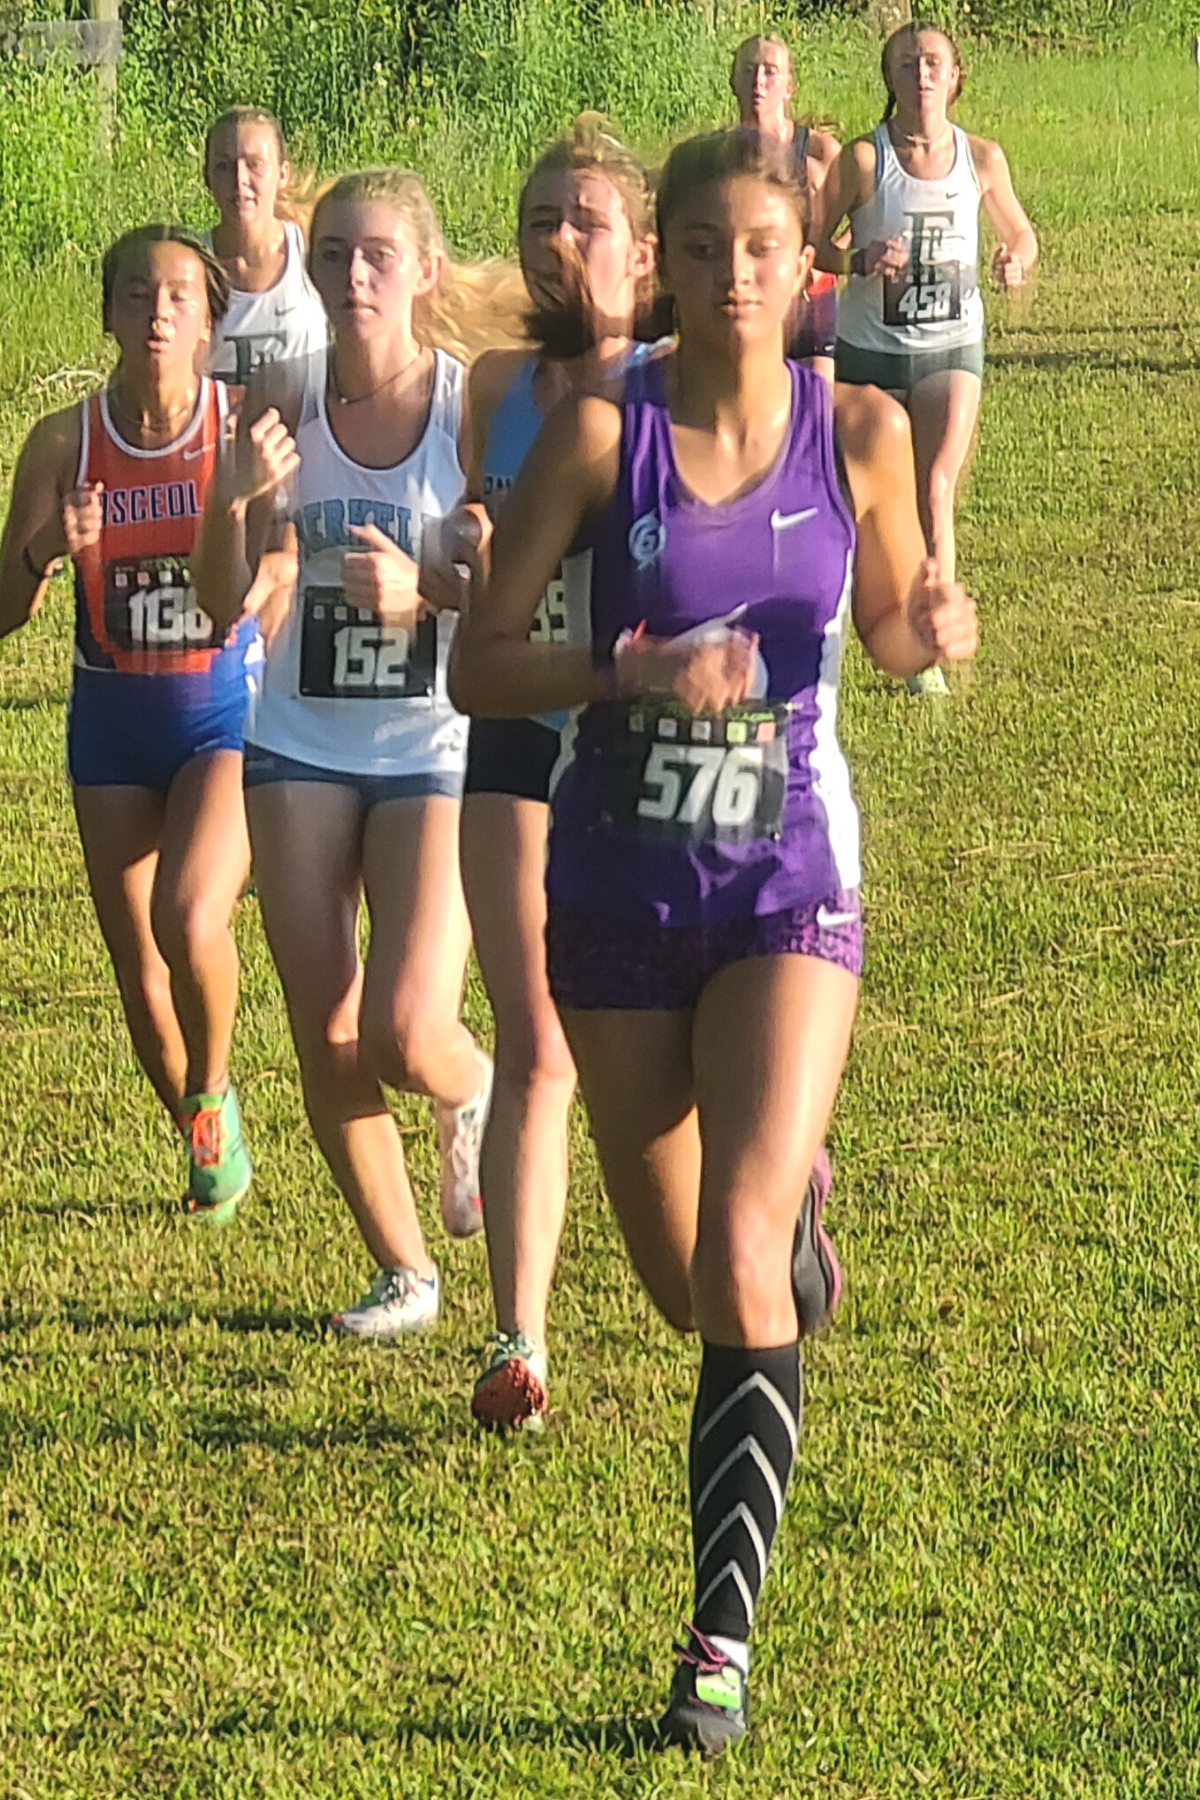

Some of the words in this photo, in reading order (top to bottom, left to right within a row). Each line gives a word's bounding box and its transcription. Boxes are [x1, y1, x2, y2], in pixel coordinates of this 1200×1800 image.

[898, 281, 951, 320] 458
[333, 625, 409, 688] 152
[637, 742, 763, 826] 576
